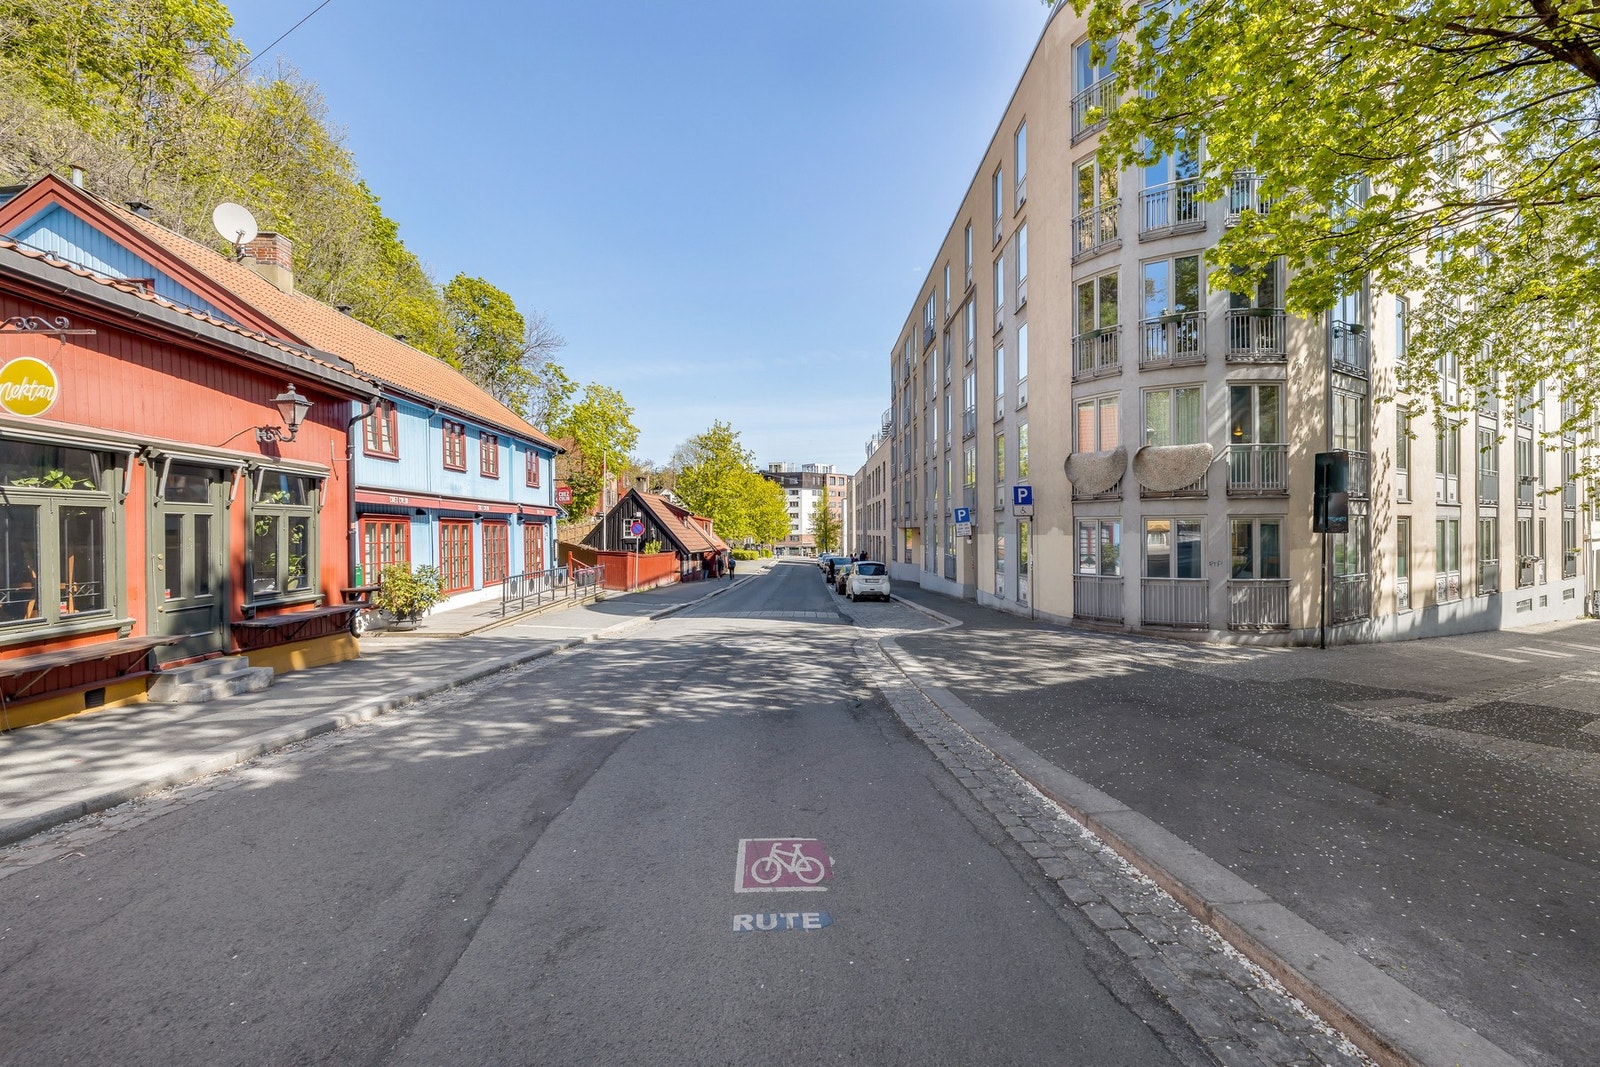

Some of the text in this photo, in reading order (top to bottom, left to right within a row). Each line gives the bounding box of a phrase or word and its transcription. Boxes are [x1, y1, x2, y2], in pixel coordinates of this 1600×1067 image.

[1018, 488, 1028, 503] P
[957, 509, 966, 522] P
[733, 912, 822, 931] RUTE
